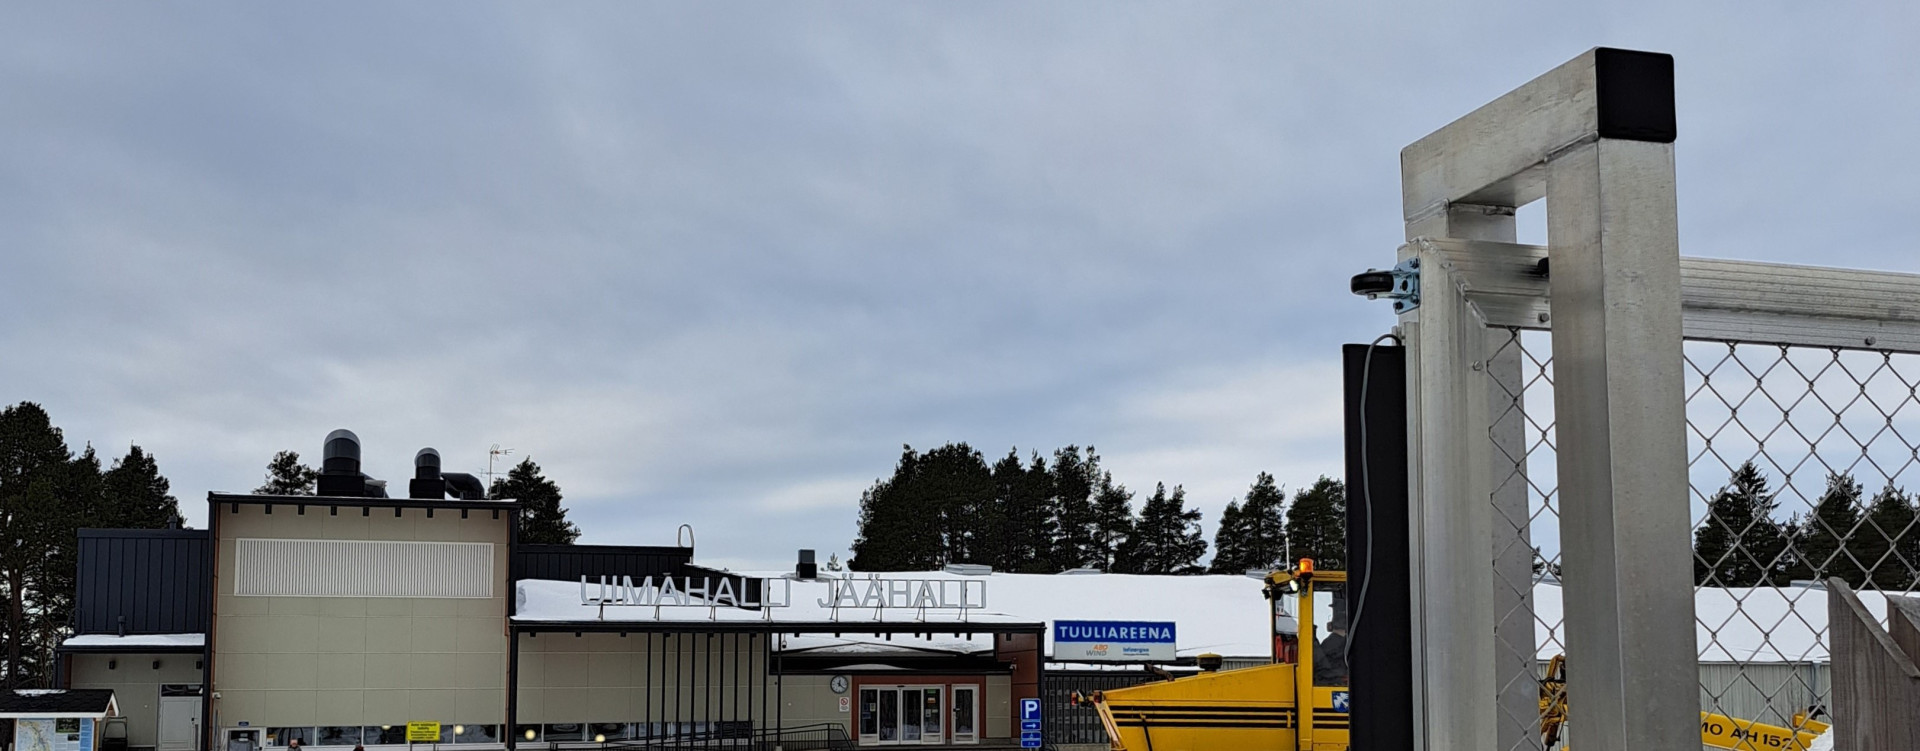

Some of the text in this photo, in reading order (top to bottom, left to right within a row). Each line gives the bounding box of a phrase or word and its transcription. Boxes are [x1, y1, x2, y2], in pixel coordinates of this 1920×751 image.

[580, 573, 986, 609] UIMAHALLI JÄÄHALLI
[1059, 626, 1171, 640] TUULIAREENA
[1025, 700, 1038, 719] P
[1730, 727, 1758, 742] AH
[1763, 733, 1792, 750] 152
